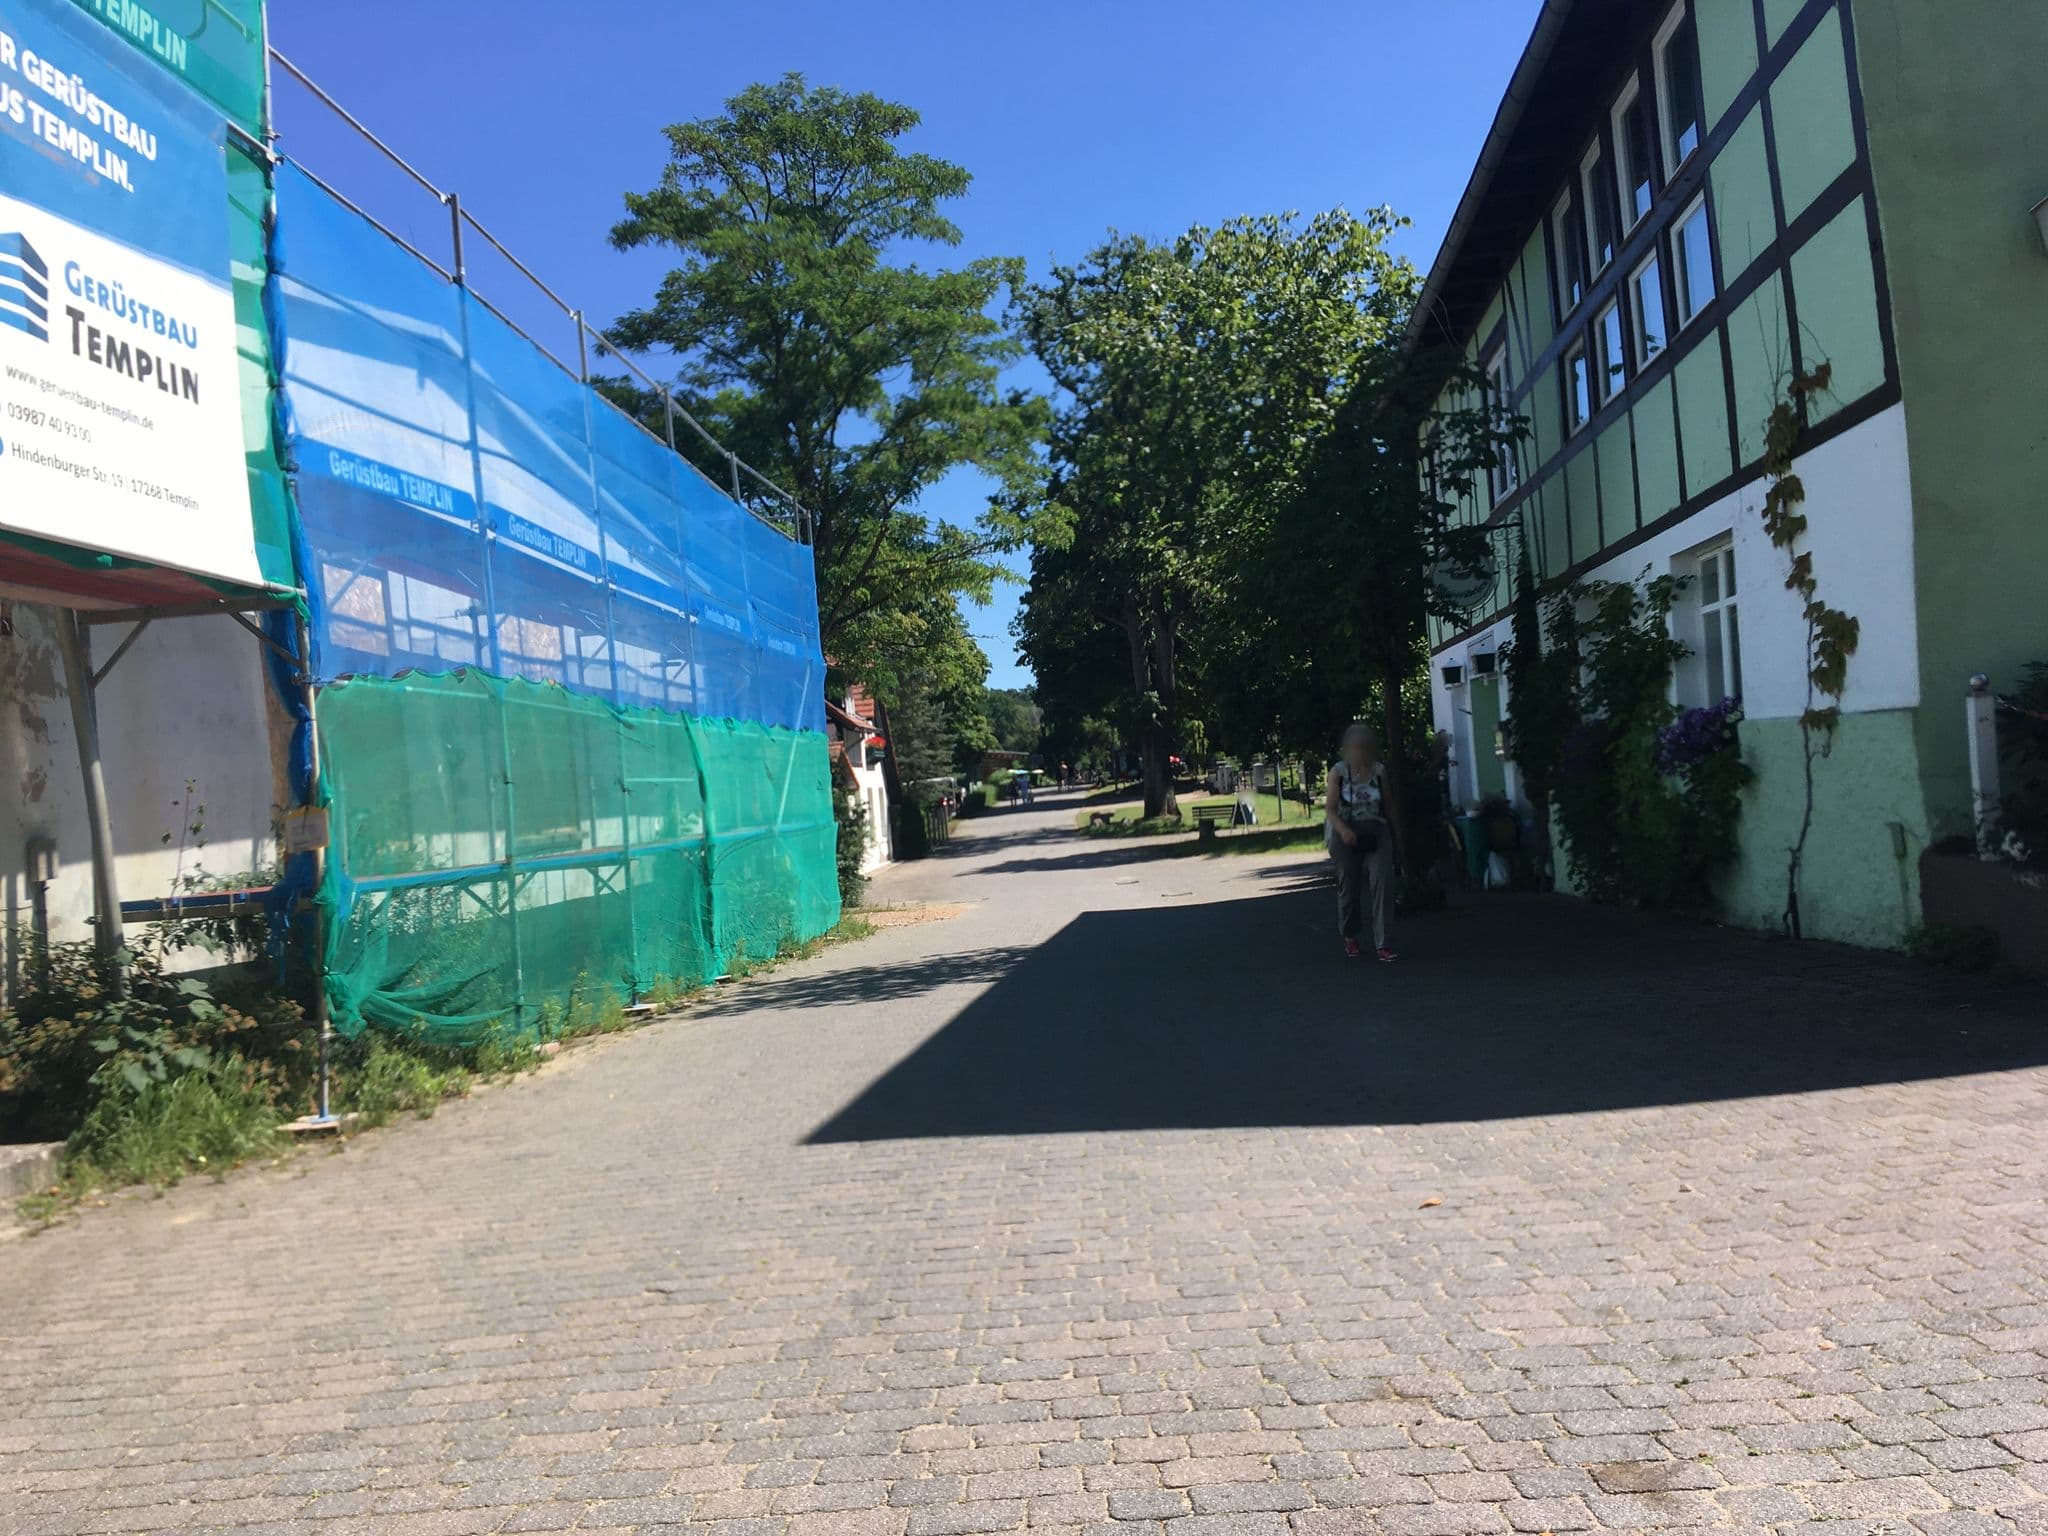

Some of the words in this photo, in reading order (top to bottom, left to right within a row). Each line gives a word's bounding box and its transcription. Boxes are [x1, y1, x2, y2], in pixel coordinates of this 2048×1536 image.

[21, 49, 157, 161] GERÜSTBAU
[27, 98, 135, 193] TEMPLIN.
[64, 260, 198, 350] GERÜSTBAU
[65, 303, 199, 405] TEMPLIN
[7, 401, 46, 427] 03987
[48, 415, 63, 433] 40
[11, 441, 91, 479] Hindenburger
[131, 478, 163, 500] 17268
[163, 487, 199, 511] Templin
[328, 450, 399, 494] Gerüstbau
[400, 473, 454, 513] TEMPLIN
[508, 514, 552, 553] Gerüstbau
[553, 535, 586, 567] TEMPLIN
